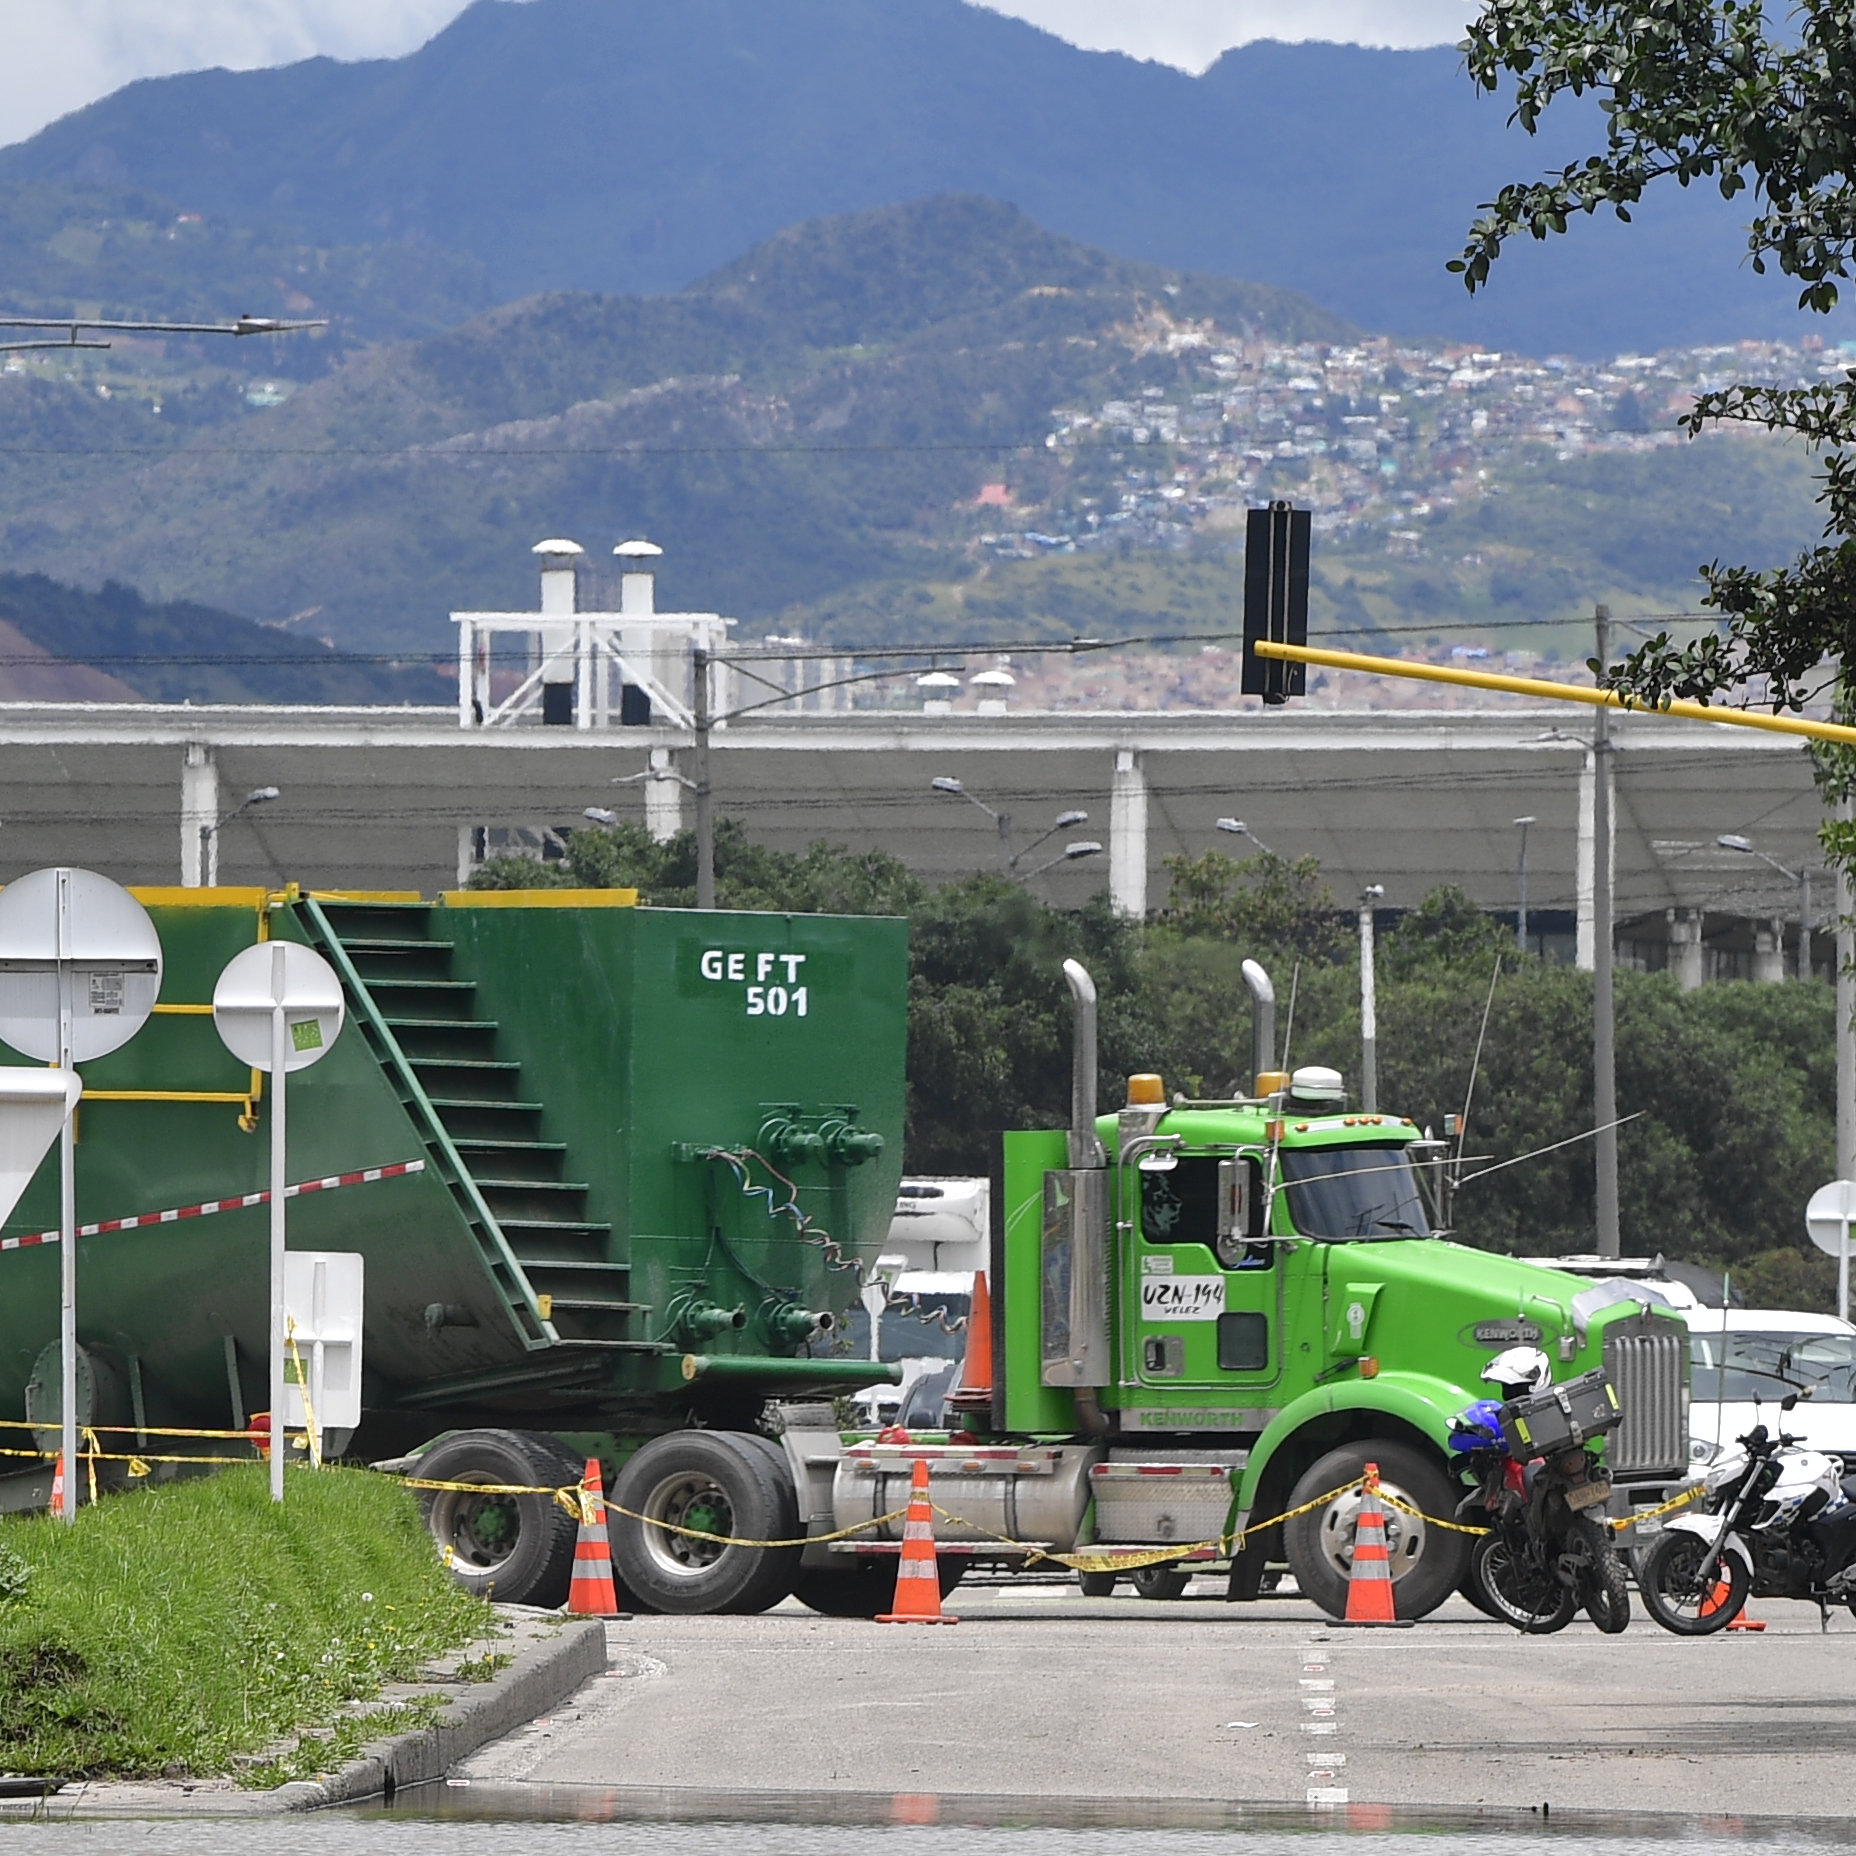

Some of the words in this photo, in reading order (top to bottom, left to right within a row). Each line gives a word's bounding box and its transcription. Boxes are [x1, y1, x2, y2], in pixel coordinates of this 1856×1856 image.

[747, 986, 808, 1017] 501
[1143, 1283, 1224, 1306] UZN-194
[1475, 1326, 1539, 1341] KENWOTH
[1140, 1412, 1244, 1427] KENWORTH
